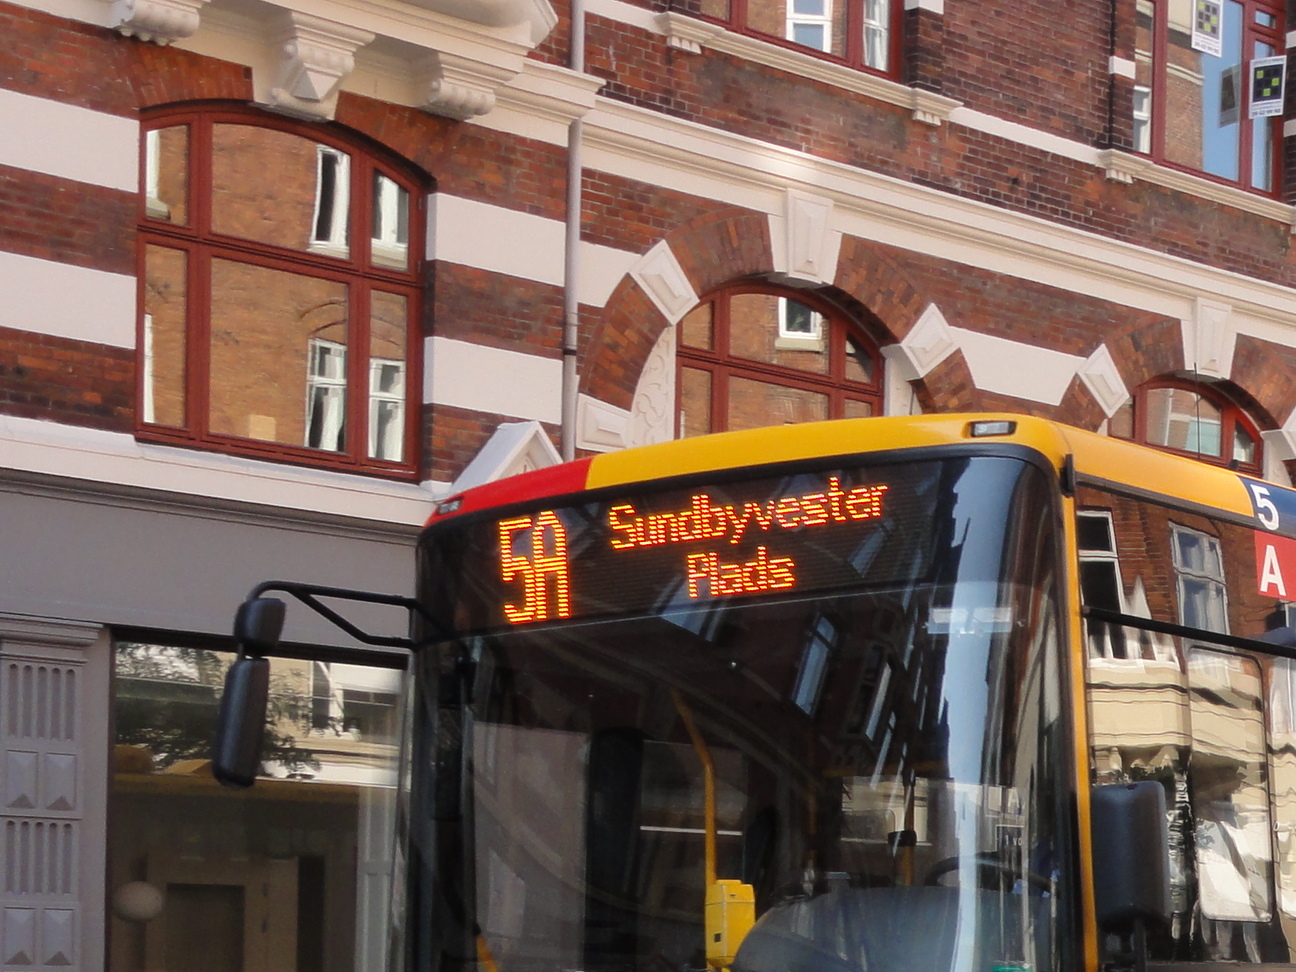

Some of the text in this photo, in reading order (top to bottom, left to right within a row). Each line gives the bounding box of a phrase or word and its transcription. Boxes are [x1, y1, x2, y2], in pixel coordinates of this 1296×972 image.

[610, 476, 889, 549] Sundbyvester
[1250, 484, 1280, 531] 5
[499, 510, 571, 624] 5A
[687, 546, 796, 599] Plads
[1260, 544, 1287, 597] A
